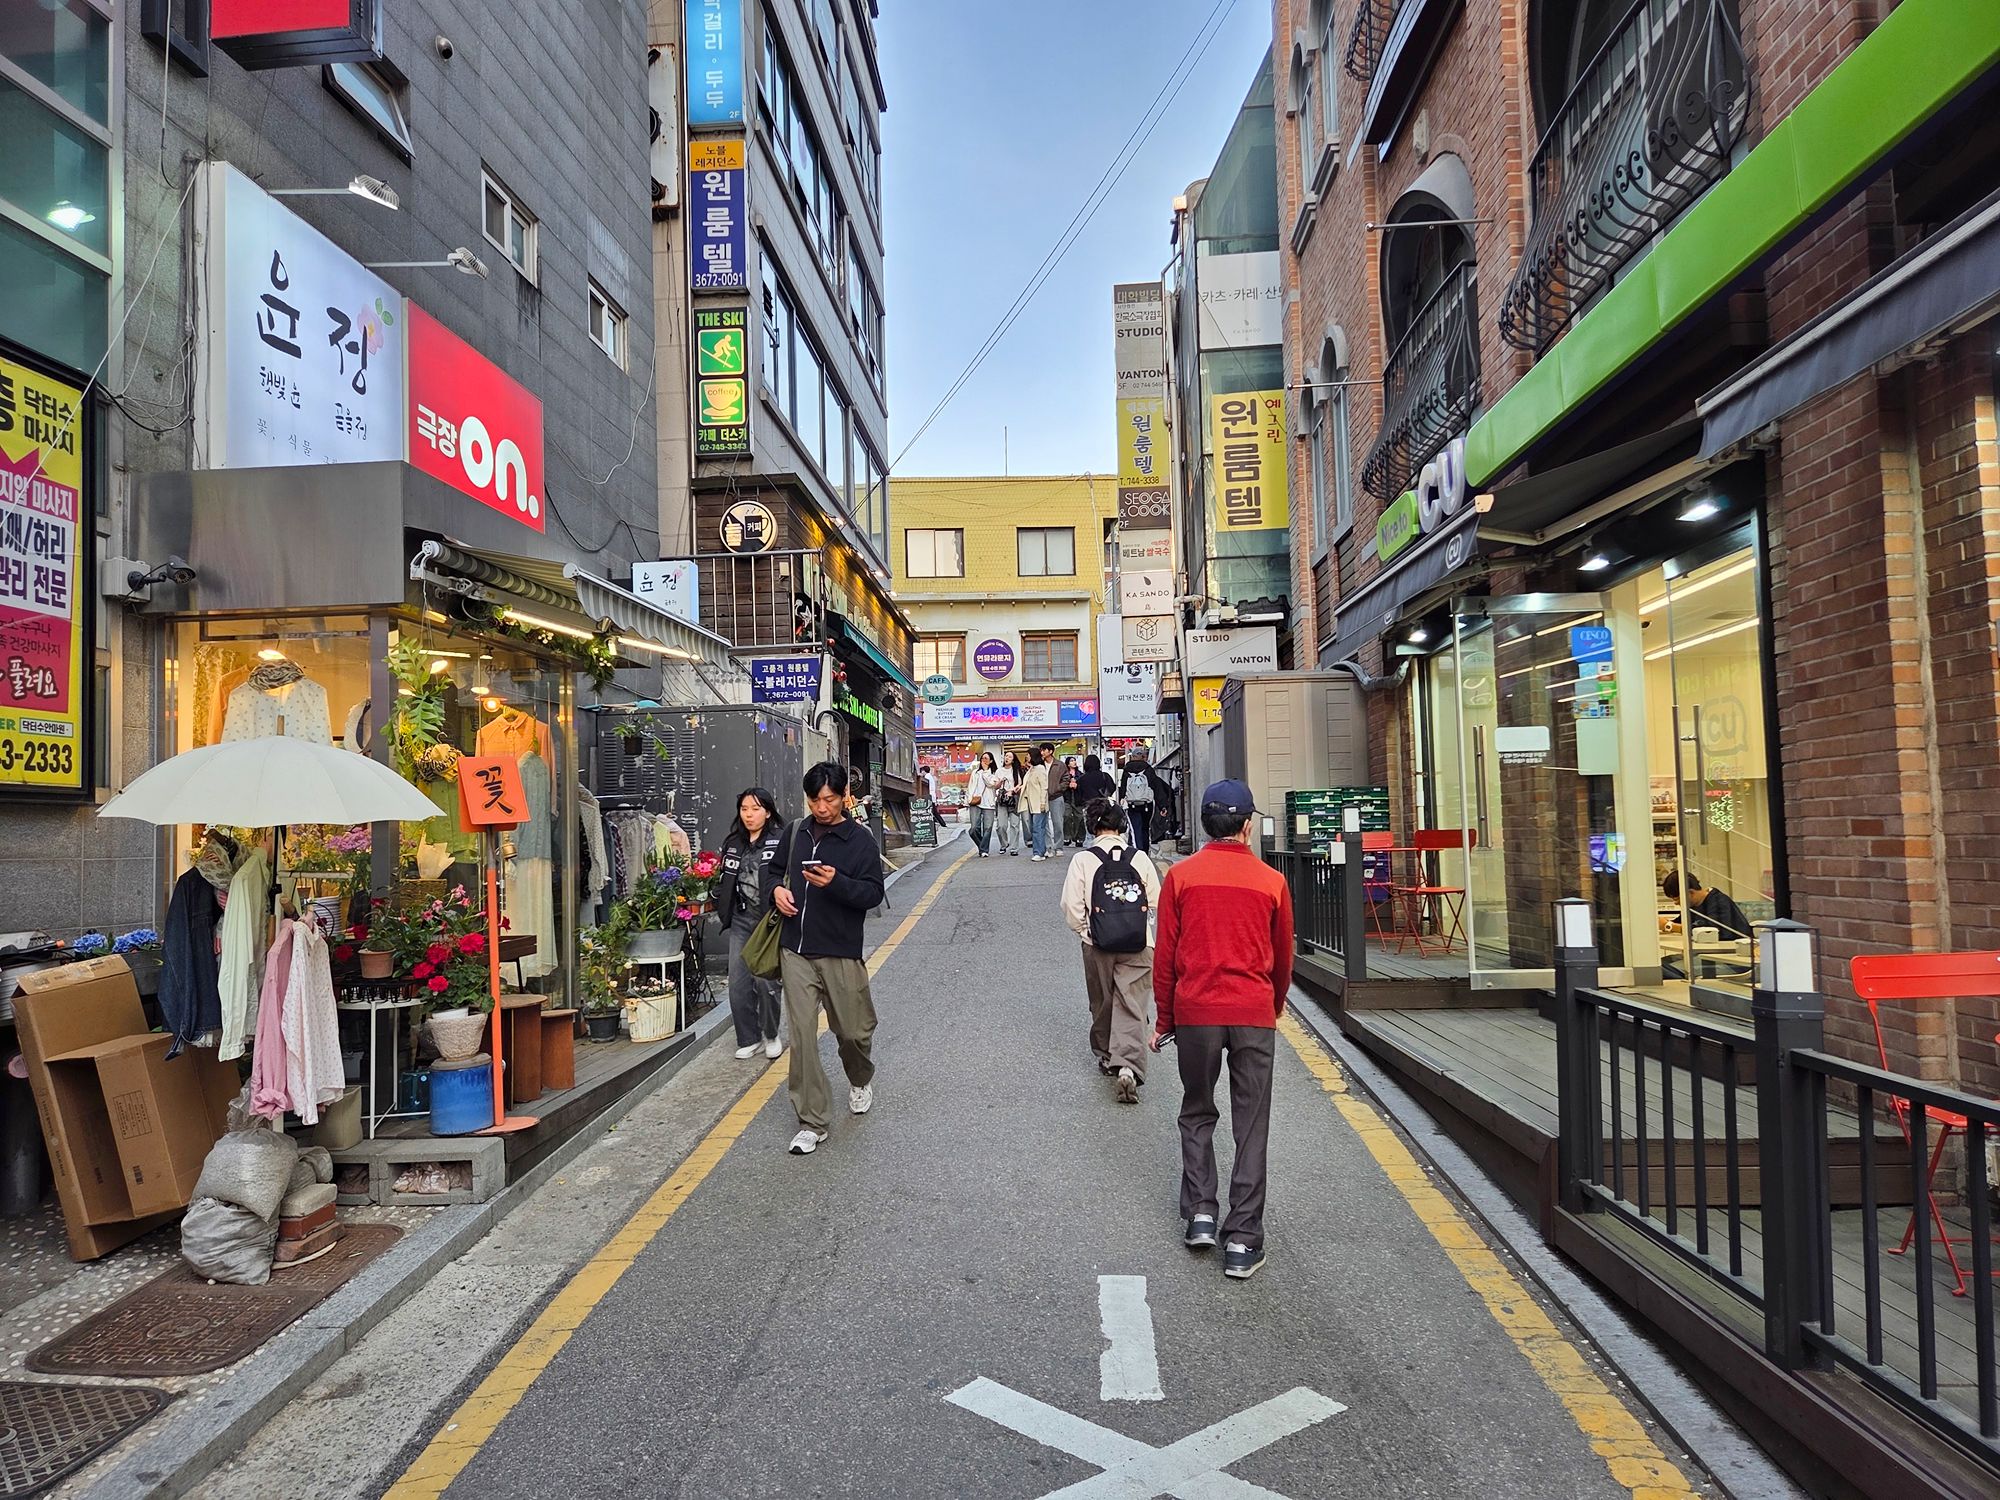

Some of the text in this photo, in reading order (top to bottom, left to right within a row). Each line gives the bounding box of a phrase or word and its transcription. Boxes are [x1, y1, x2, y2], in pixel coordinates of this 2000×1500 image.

[729, 110, 741, 119] 2F
[706, 145, 727, 156] 노블
[695, 157, 737, 167] 레지던스
[702, 171, 734, 273] 원룸텔
[695, 272, 743, 287] 3672-0091
[697, 311, 744, 327] THE SKI
[1117, 327, 1163, 338] STUDIO
[1117, 369, 1164, 379] VANTON
[24, 385, 74, 425] 닥터수
[24, 415, 74, 456] 마사지
[417, 403, 458, 459] 극장
[698, 427, 747, 441] 카페 더스키
[1131, 414, 1153, 475] 원룸텔
[1221, 399, 1283, 527] 원룸텔 예그린
[1417, 437, 1466, 534] CU
[32, 481, 73, 521] 마사지
[1125, 492, 1171, 506] SEOGA
[1127, 504, 1171, 517] COOK
[1119, 520, 1129, 529] 2F
[34, 564, 66, 609] 전문
[1192, 634, 1230, 643] STUDIO
[1580, 630, 1609, 641] CESCO
[1229, 655, 1272, 664] VANTON
[762, 662, 810, 674] 고품격 원룸텔
[753, 674, 818, 690] 노블레지던스
[962, 705, 1019, 719] BEURRE
[475, 766, 513, 815] 꽃
